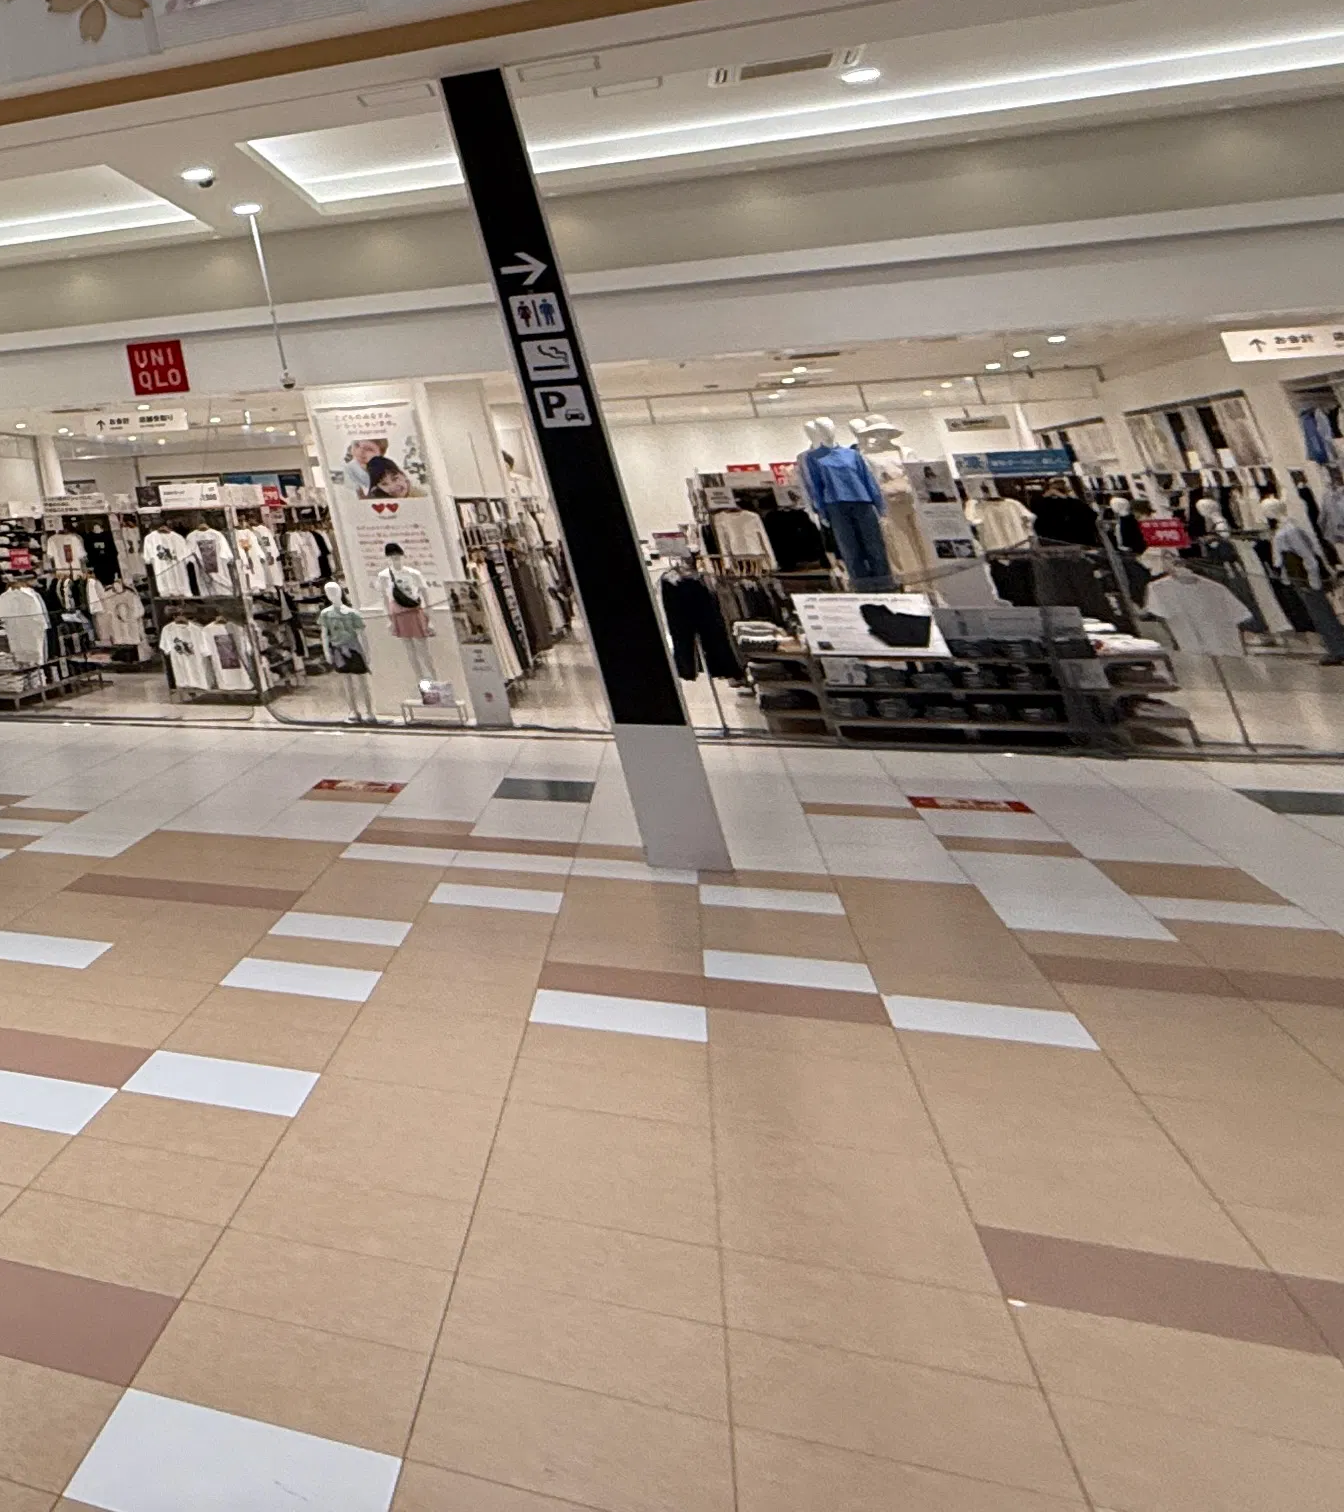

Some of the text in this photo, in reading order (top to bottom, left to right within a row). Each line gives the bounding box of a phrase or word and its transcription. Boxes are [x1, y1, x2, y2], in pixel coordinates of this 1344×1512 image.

[133, 347, 175, 368] UNI
[138, 368, 182, 391] QLO
[539, 391, 569, 420] P
